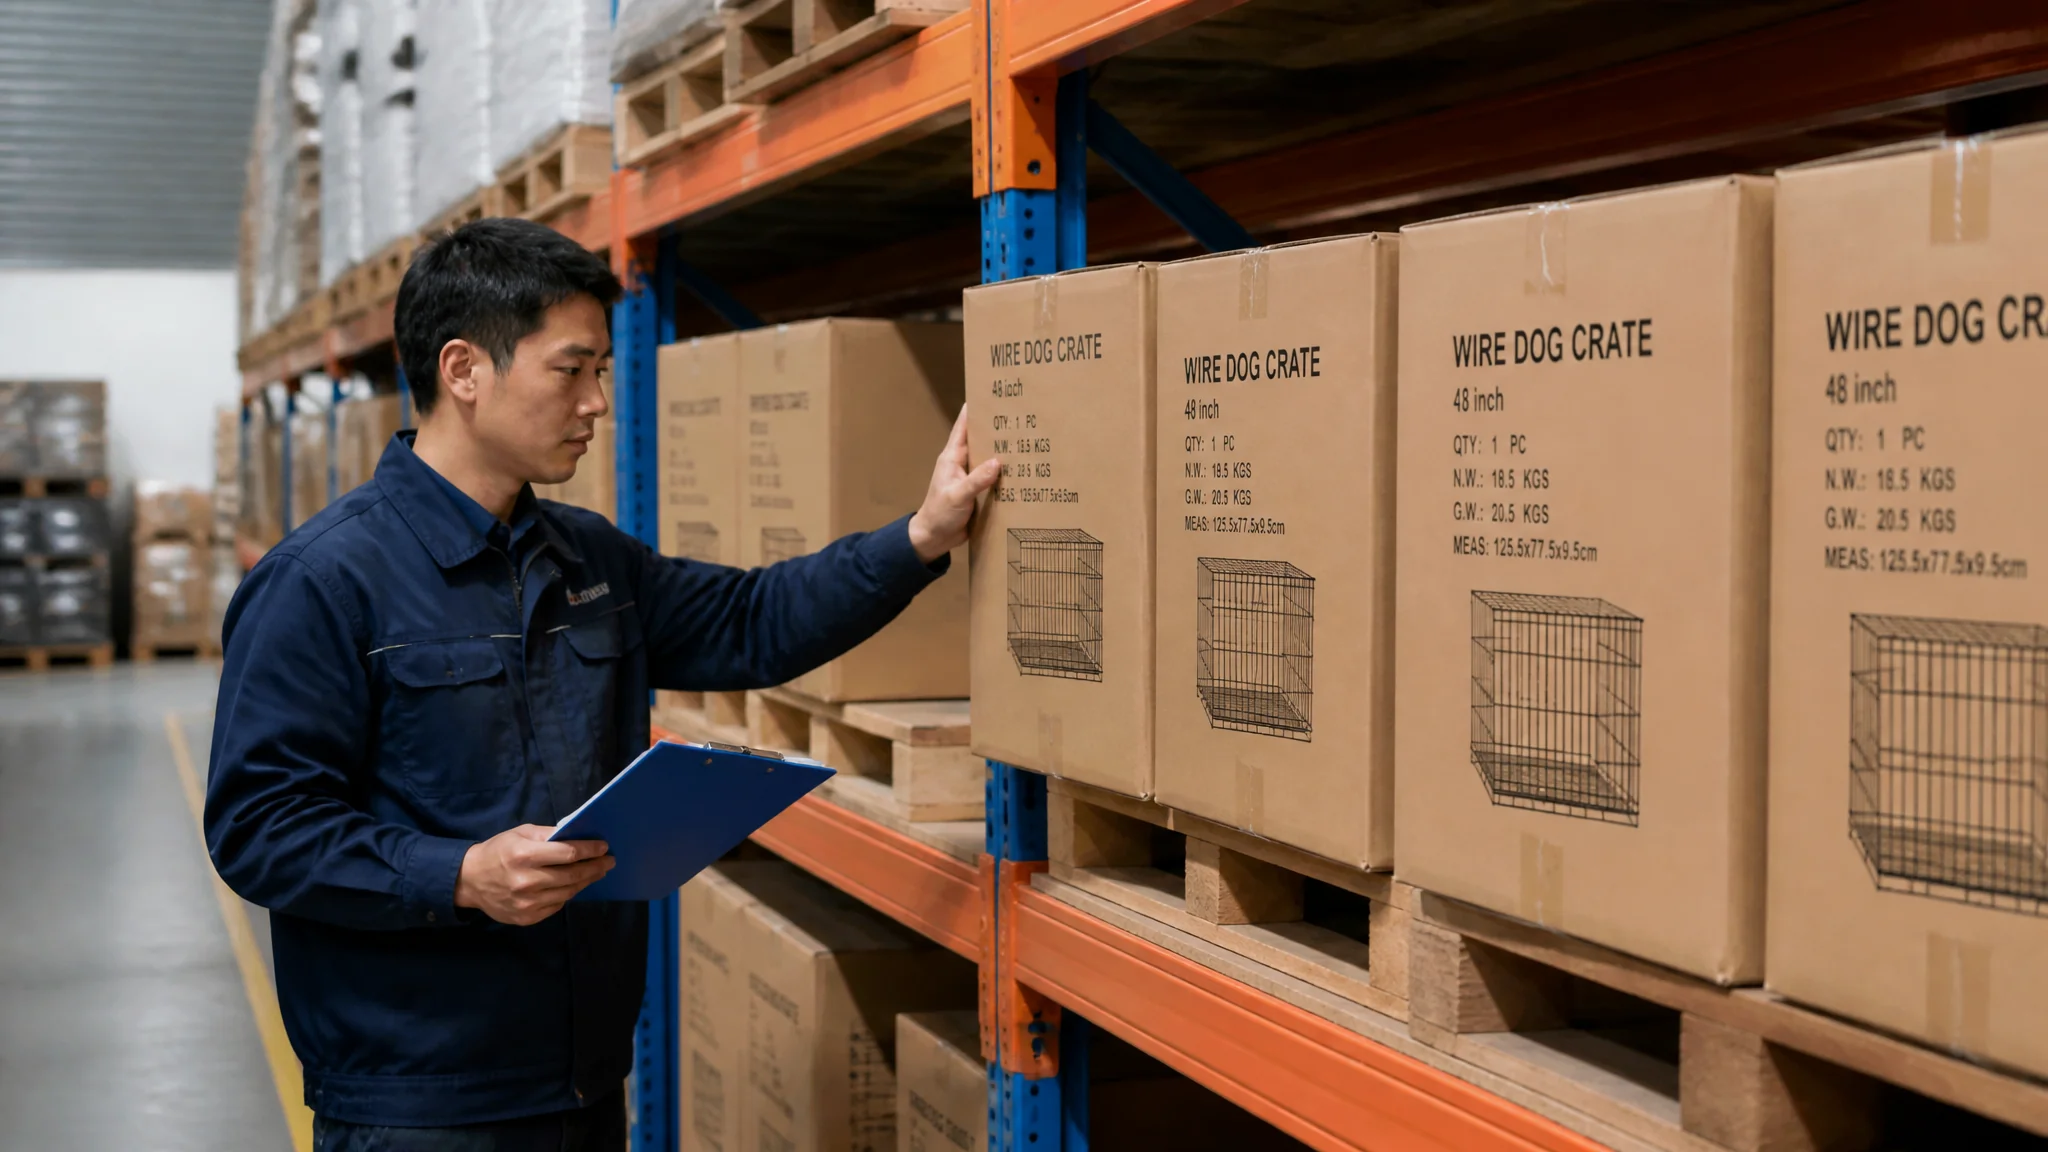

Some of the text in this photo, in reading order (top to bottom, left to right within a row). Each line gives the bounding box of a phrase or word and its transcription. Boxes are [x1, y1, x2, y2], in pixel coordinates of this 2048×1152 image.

[1826, 294, 2048, 352] WIRE DOG CR
[991, 333, 1102, 368] WIRE DOG CRATE
[1453, 318, 1652, 368] WIRE DOG CRATE
[1184, 346, 1320, 384] WIRE DOG CRATE
[1453, 386, 1503, 412] 48 inch
[1825, 372, 1896, 405] 48 inch
[1185, 399, 1219, 420] 48 inch
[1016, 416, 1019, 429] 1
[1026, 414, 1036, 428] PC
[1035, 438, 1050, 452] KGS
[1185, 435, 1234, 453] QTY: 1 PC
[1454, 434, 1526, 456] QTY: 1 PC
[1825, 426, 1925, 453] QTY: 1 PC
[1036, 463, 1051, 477] KGS
[1212, 463, 1228, 478] 18.5
[1233, 462, 1251, 478] KGS
[1454, 468, 1549, 489] N.W.: 18.5 KGS
[1877, 468, 1909, 492] 18.5
[1920, 467, 1956, 492] KGS
[1212, 490, 1228, 505] 20.5
[1234, 489, 1251, 505] KGS
[1185, 516, 1209, 531] MEAS:
[1454, 501, 1549, 524] G.W.: 20.5 KGS
[1876, 508, 1909, 532] 20.5
[1920, 508, 1956, 533] KGS
[1454, 536, 1597, 561] MEAS: 125.5x77.5x9.5cm
[1825, 546, 1873, 570] MEAS:
